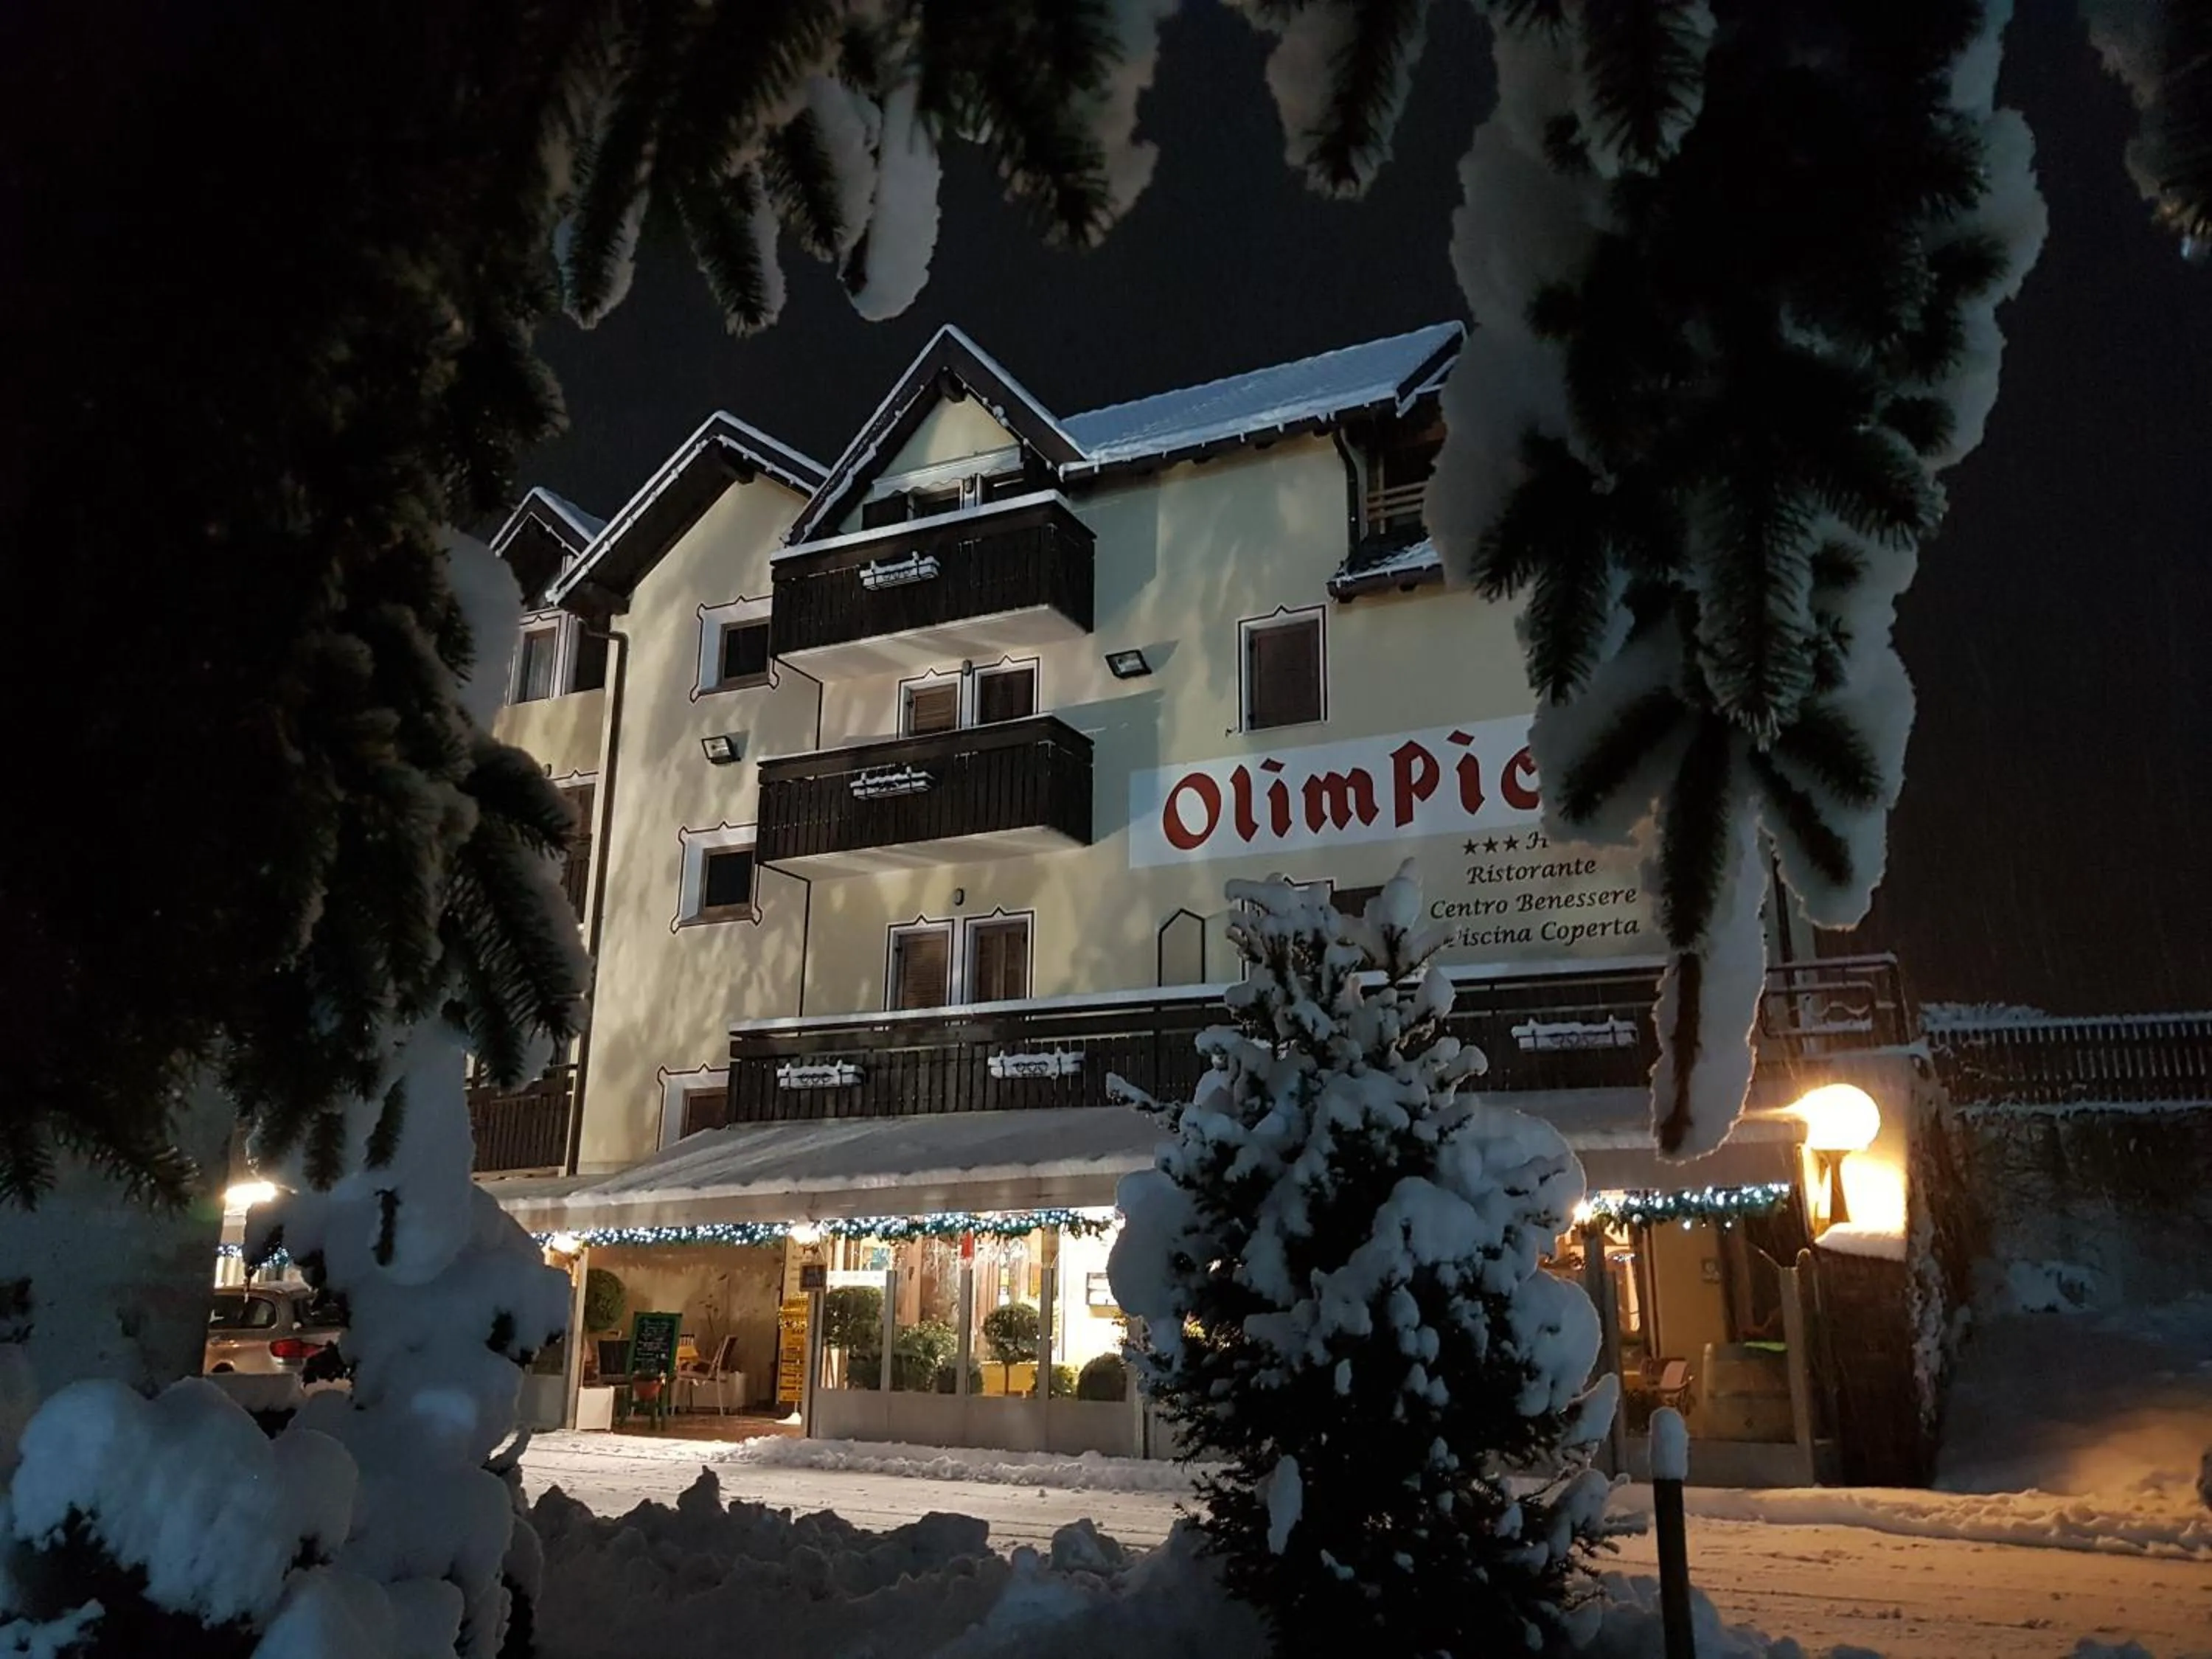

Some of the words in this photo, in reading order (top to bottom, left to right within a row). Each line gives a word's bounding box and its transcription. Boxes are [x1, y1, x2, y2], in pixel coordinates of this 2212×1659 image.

[1467, 858, 1596, 885] Ristorante
[1430, 900, 1508, 919] Centro
[1515, 888, 1637, 913] Benessere
[1541, 918, 1640, 947] Coperta
